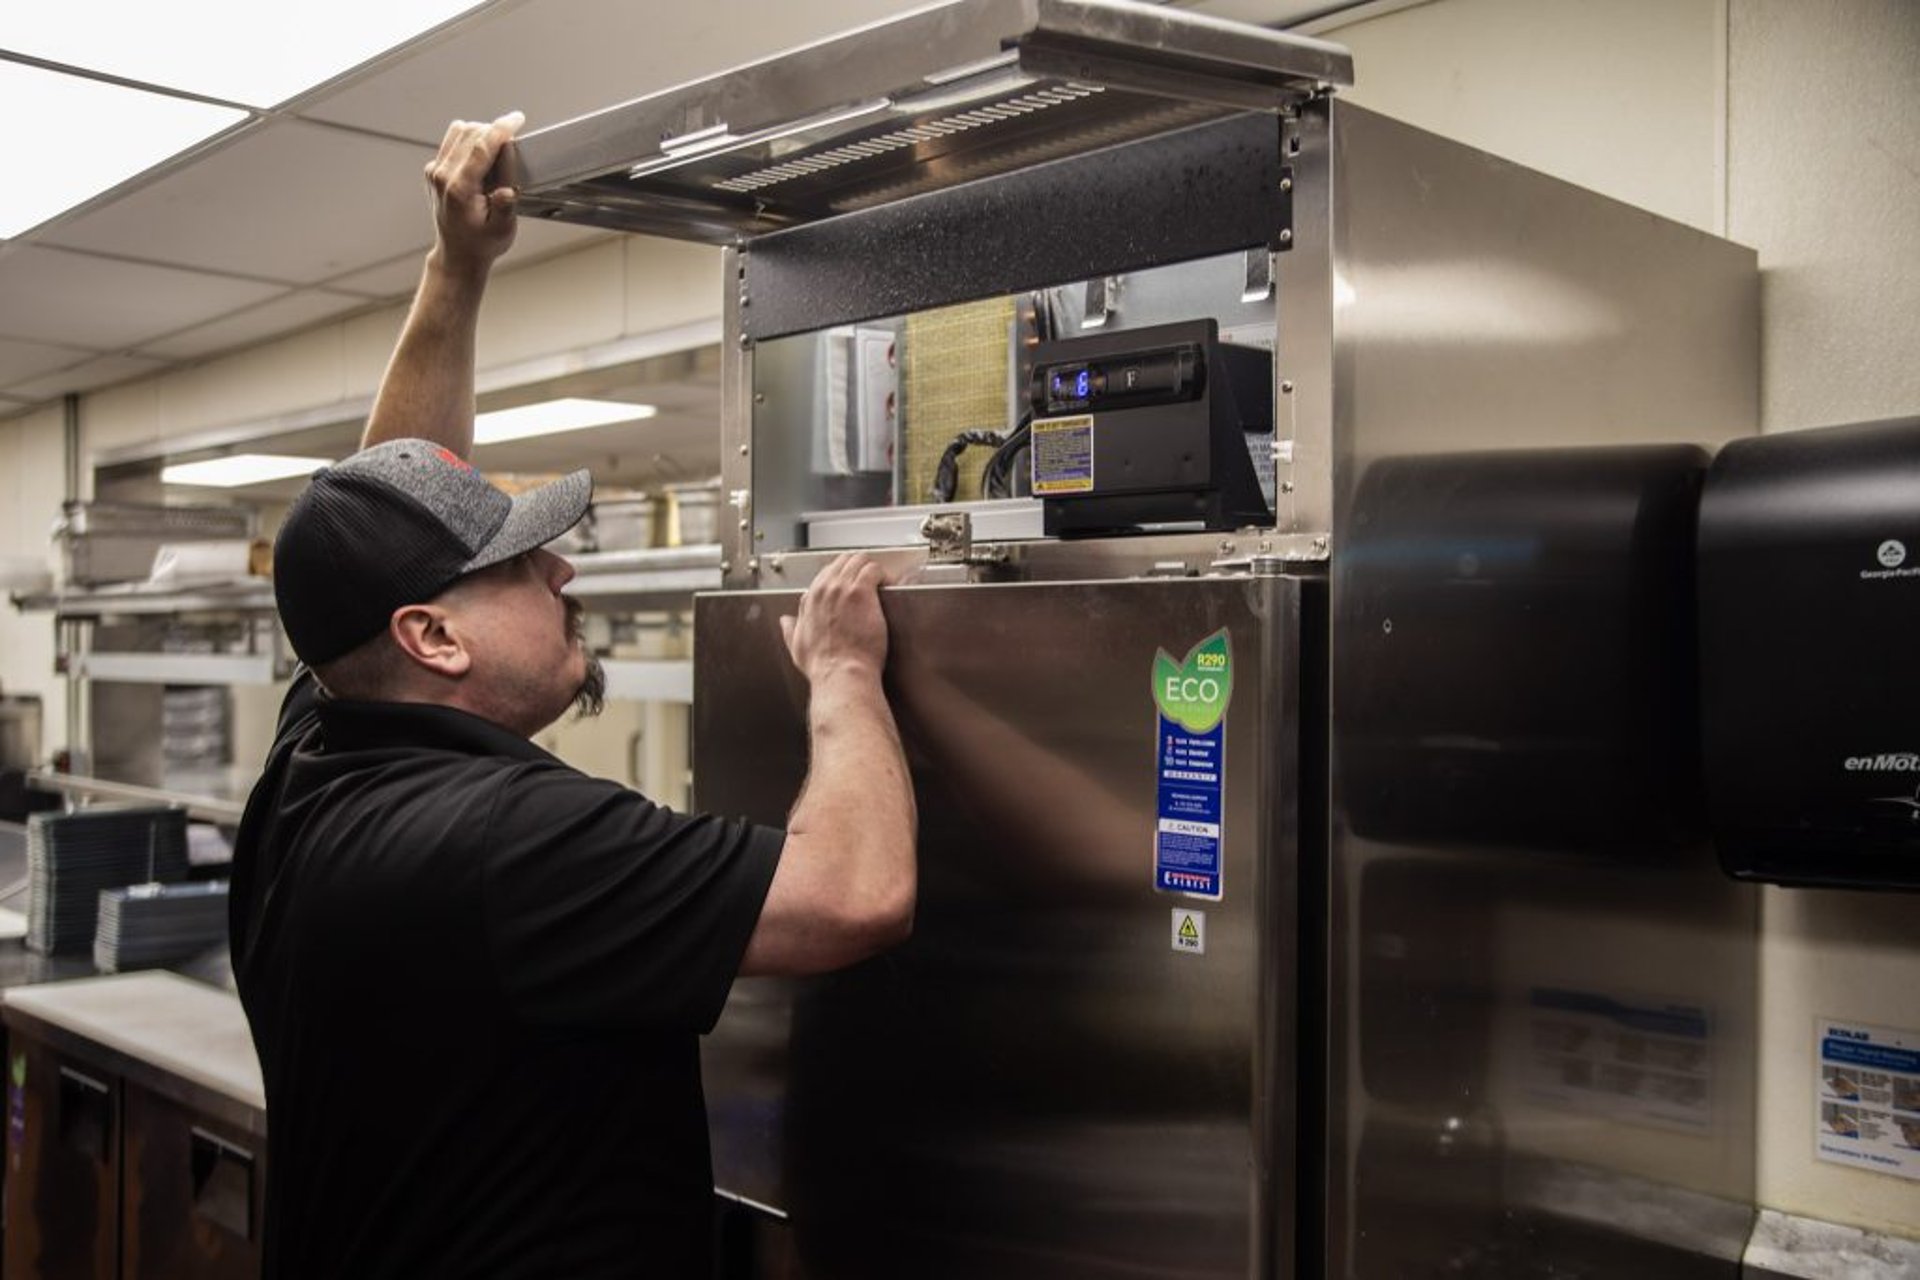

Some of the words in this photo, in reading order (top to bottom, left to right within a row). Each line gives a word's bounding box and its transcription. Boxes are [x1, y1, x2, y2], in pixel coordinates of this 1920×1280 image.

[1197, 653, 1225, 667] R290
[1166, 677, 1219, 702] ECO
[1177, 823, 1208, 834] CAUTION
